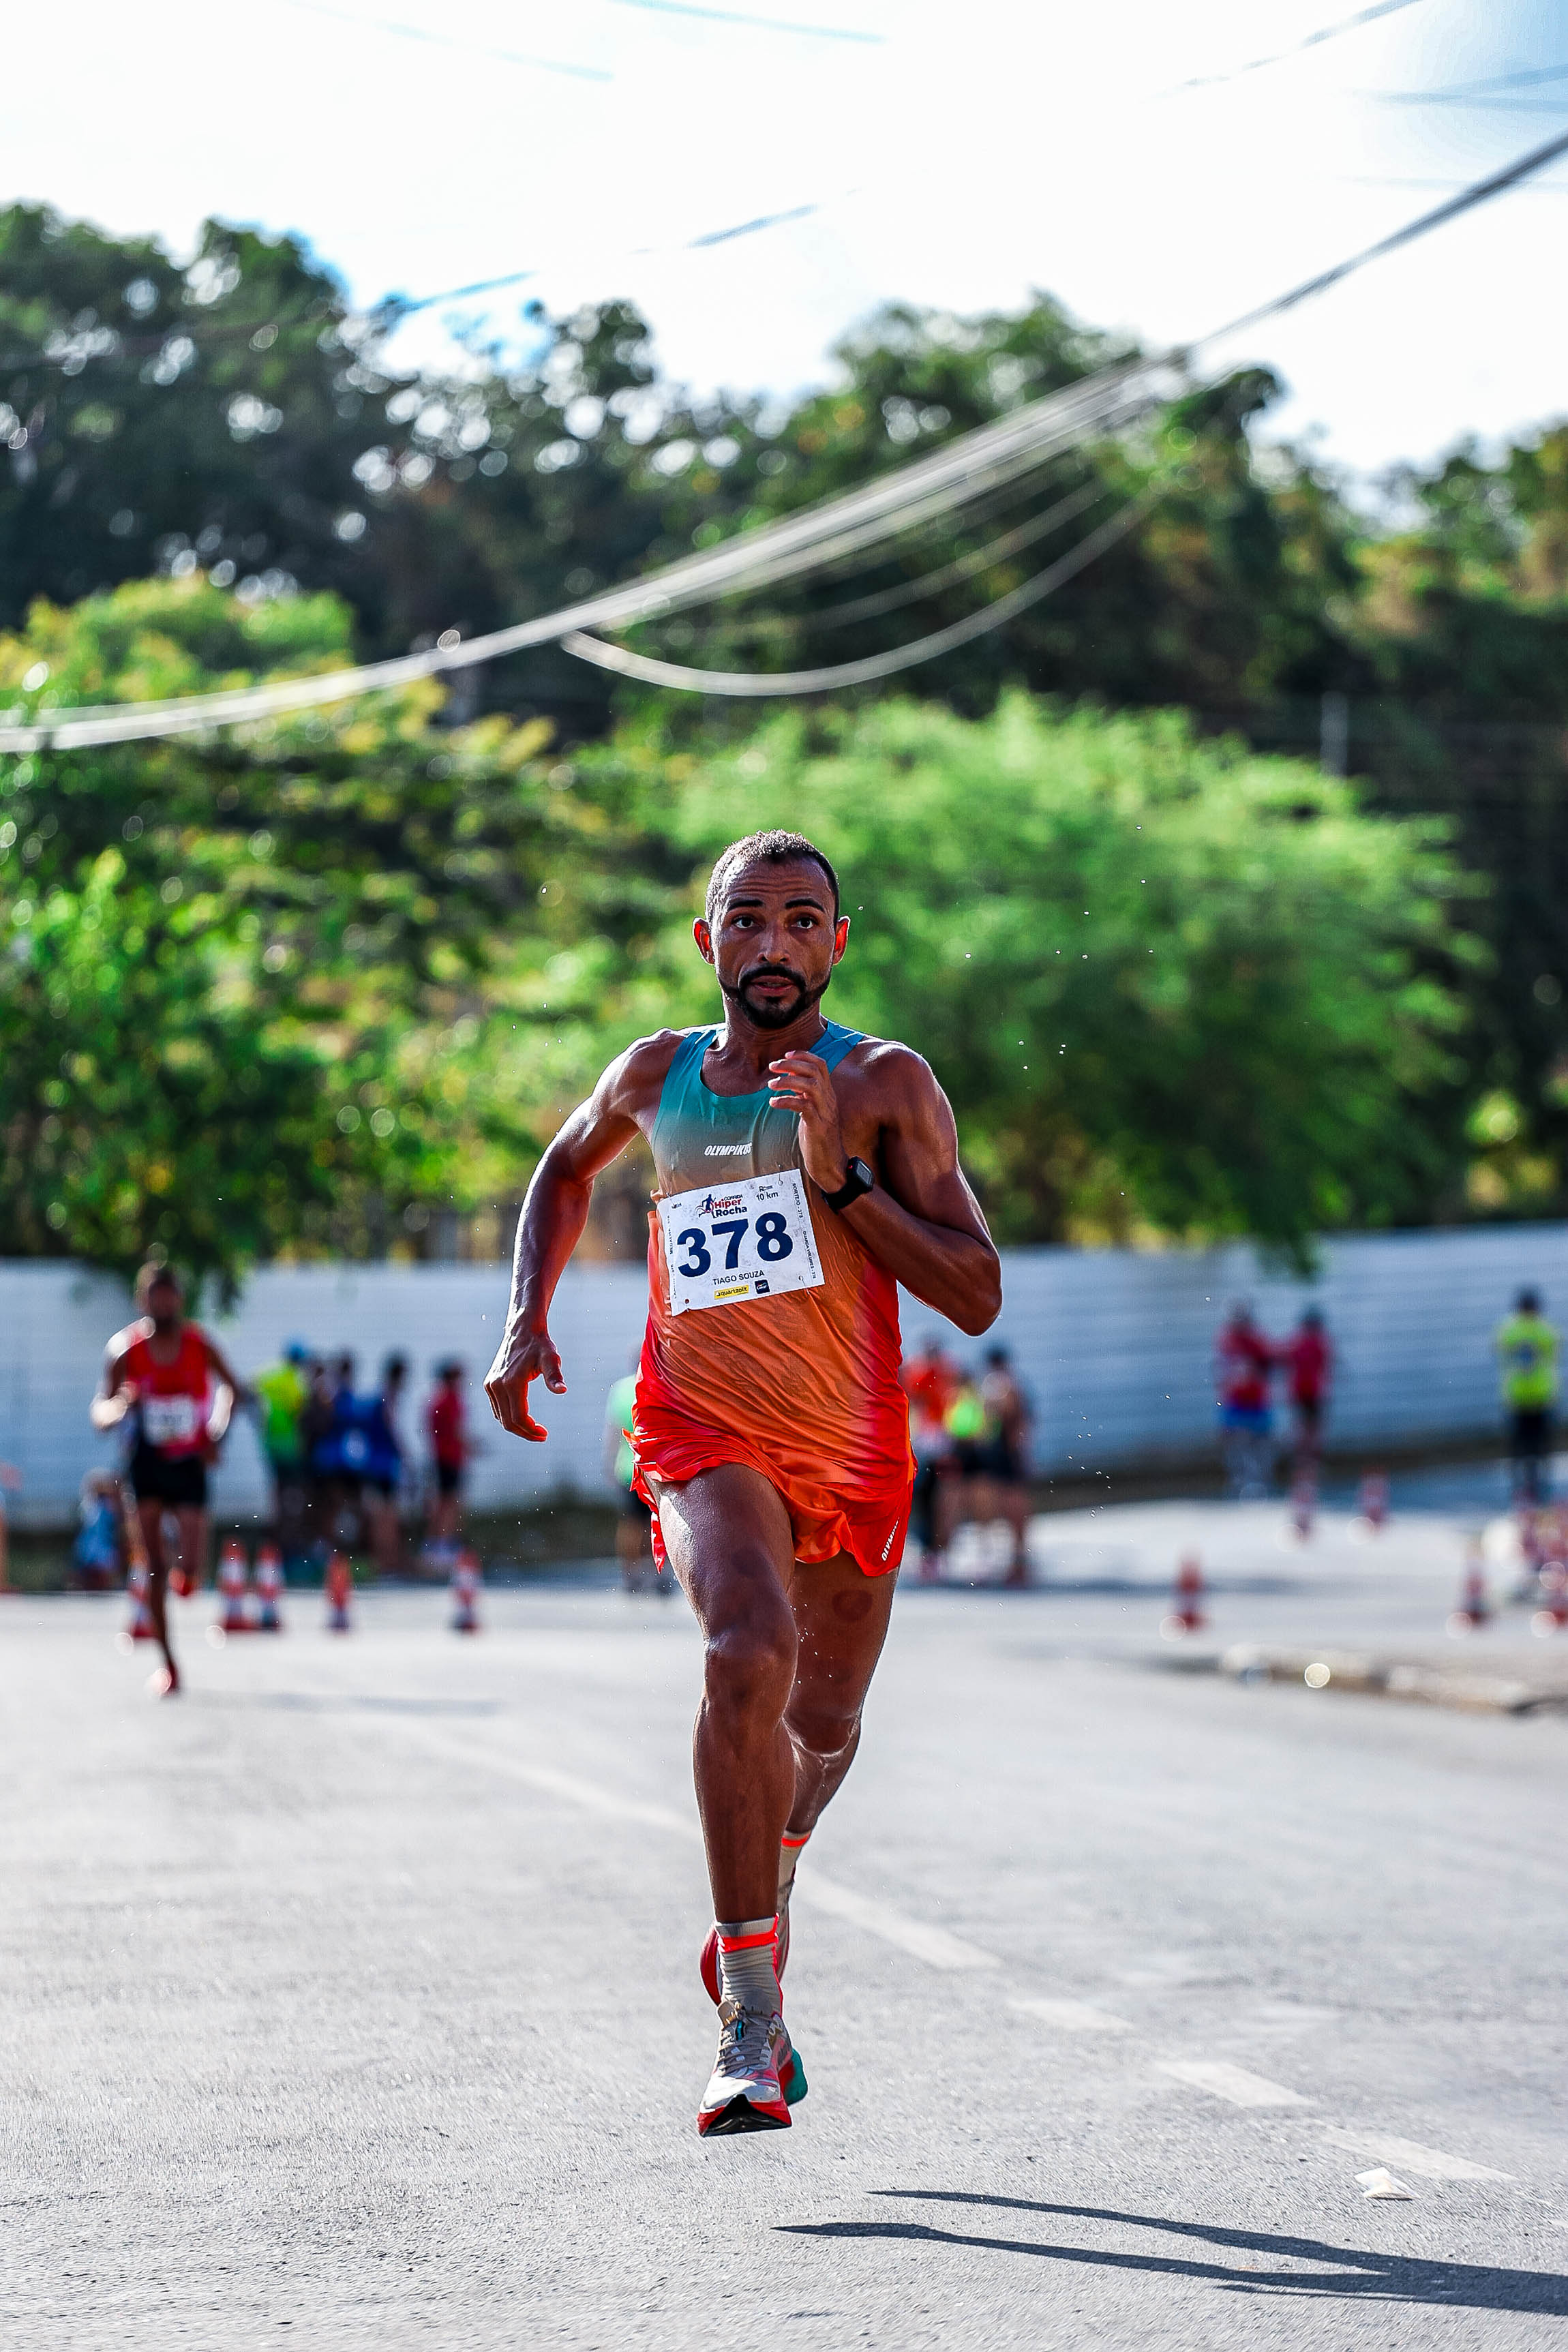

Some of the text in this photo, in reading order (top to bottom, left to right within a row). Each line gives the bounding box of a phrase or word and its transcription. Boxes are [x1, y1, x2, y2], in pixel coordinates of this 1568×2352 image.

[756, 1191, 779, 1201] 10 km
[714, 1198, 742, 1209] Hiper
[715, 1206, 748, 1218] Rocha
[677, 1211, 794, 1278] 378
[712, 1269, 765, 1285] TIAGO SOUZA
[721, 1286, 748, 1296] quartzolit
